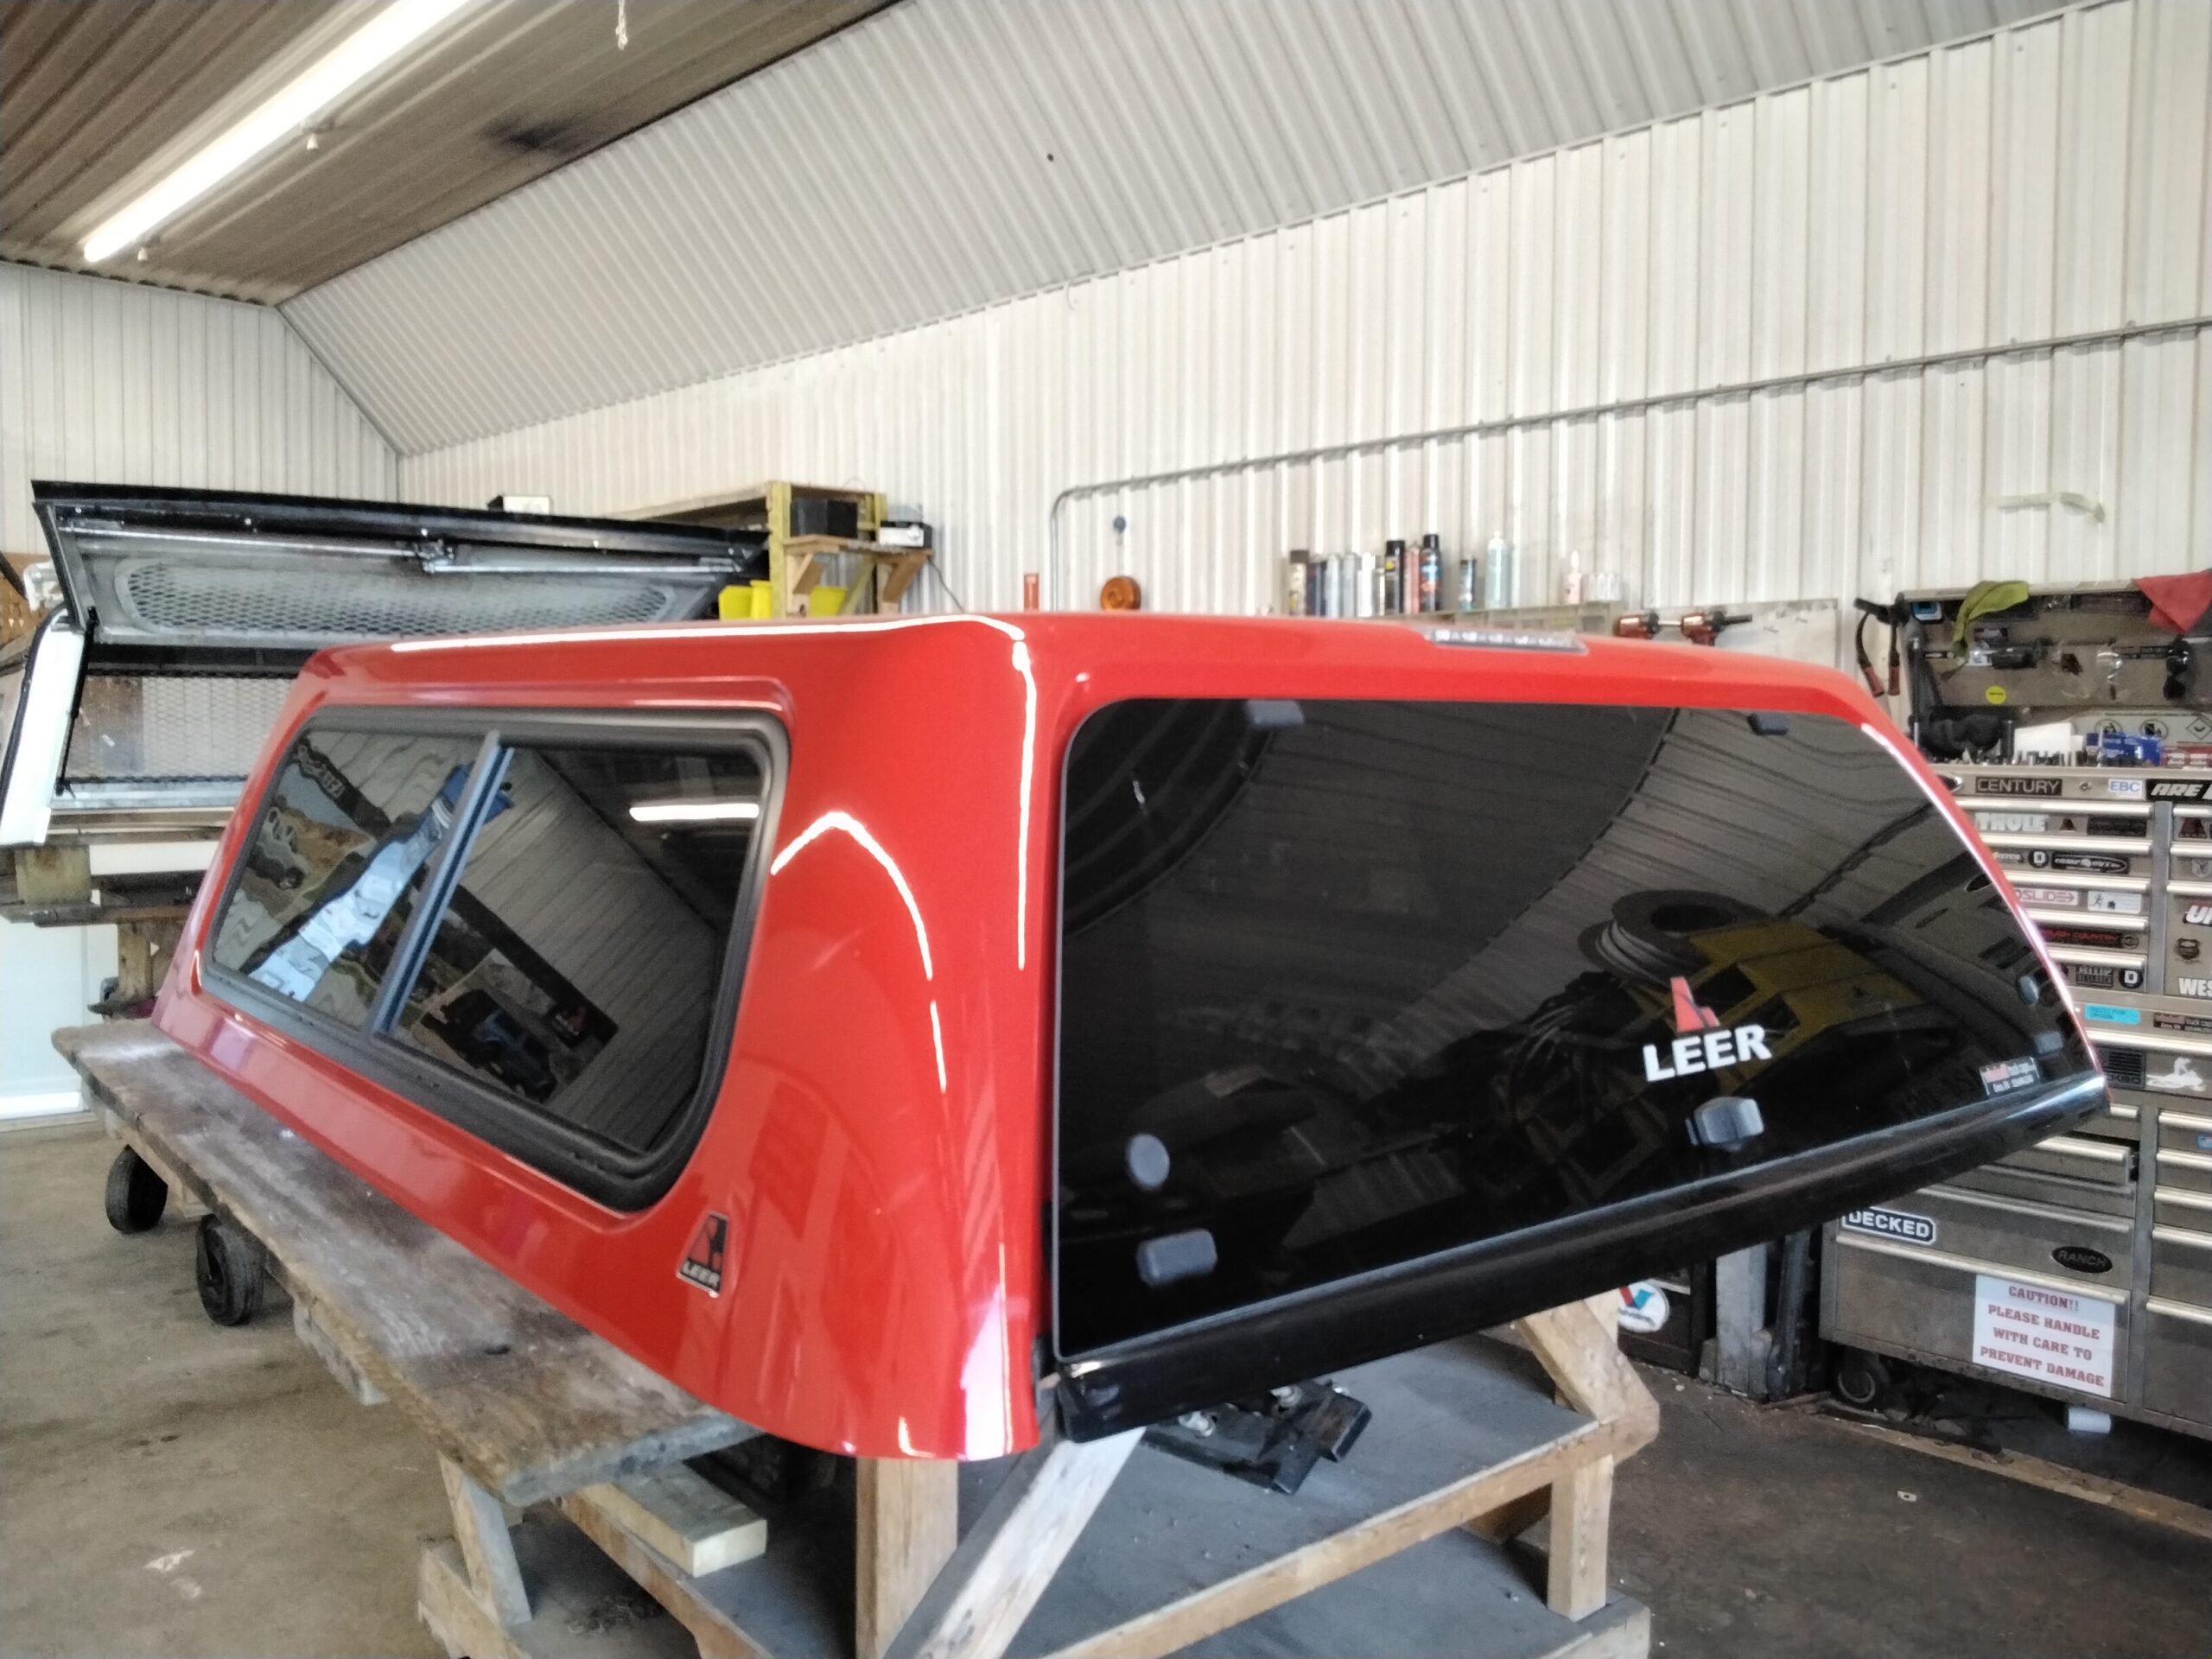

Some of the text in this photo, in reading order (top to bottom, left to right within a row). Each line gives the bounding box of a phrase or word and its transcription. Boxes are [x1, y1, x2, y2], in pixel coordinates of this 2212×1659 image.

[1977, 780, 2060, 794] CENTURY
[2110, 781, 2140, 792] EBC
[2151, 783, 2203, 797] ARE
[1975, 813, 2049, 832] THULE
[2033, 851, 2046, 864] D
[2124, 970, 2139, 984] D
[1643, 1024, 1772, 1082] LEER
[1849, 1211, 1929, 1238] DECKED
[2058, 1250, 2106, 1268] RANCH
[2008, 1286, 2079, 1312] CAUTION!!
[1988, 1304, 2100, 1340] PLEASE HANDLE
[1993, 1327, 2093, 1361] WITH CARE TO
[1980, 1346, 2105, 1387] PREVENT DAMAGE
